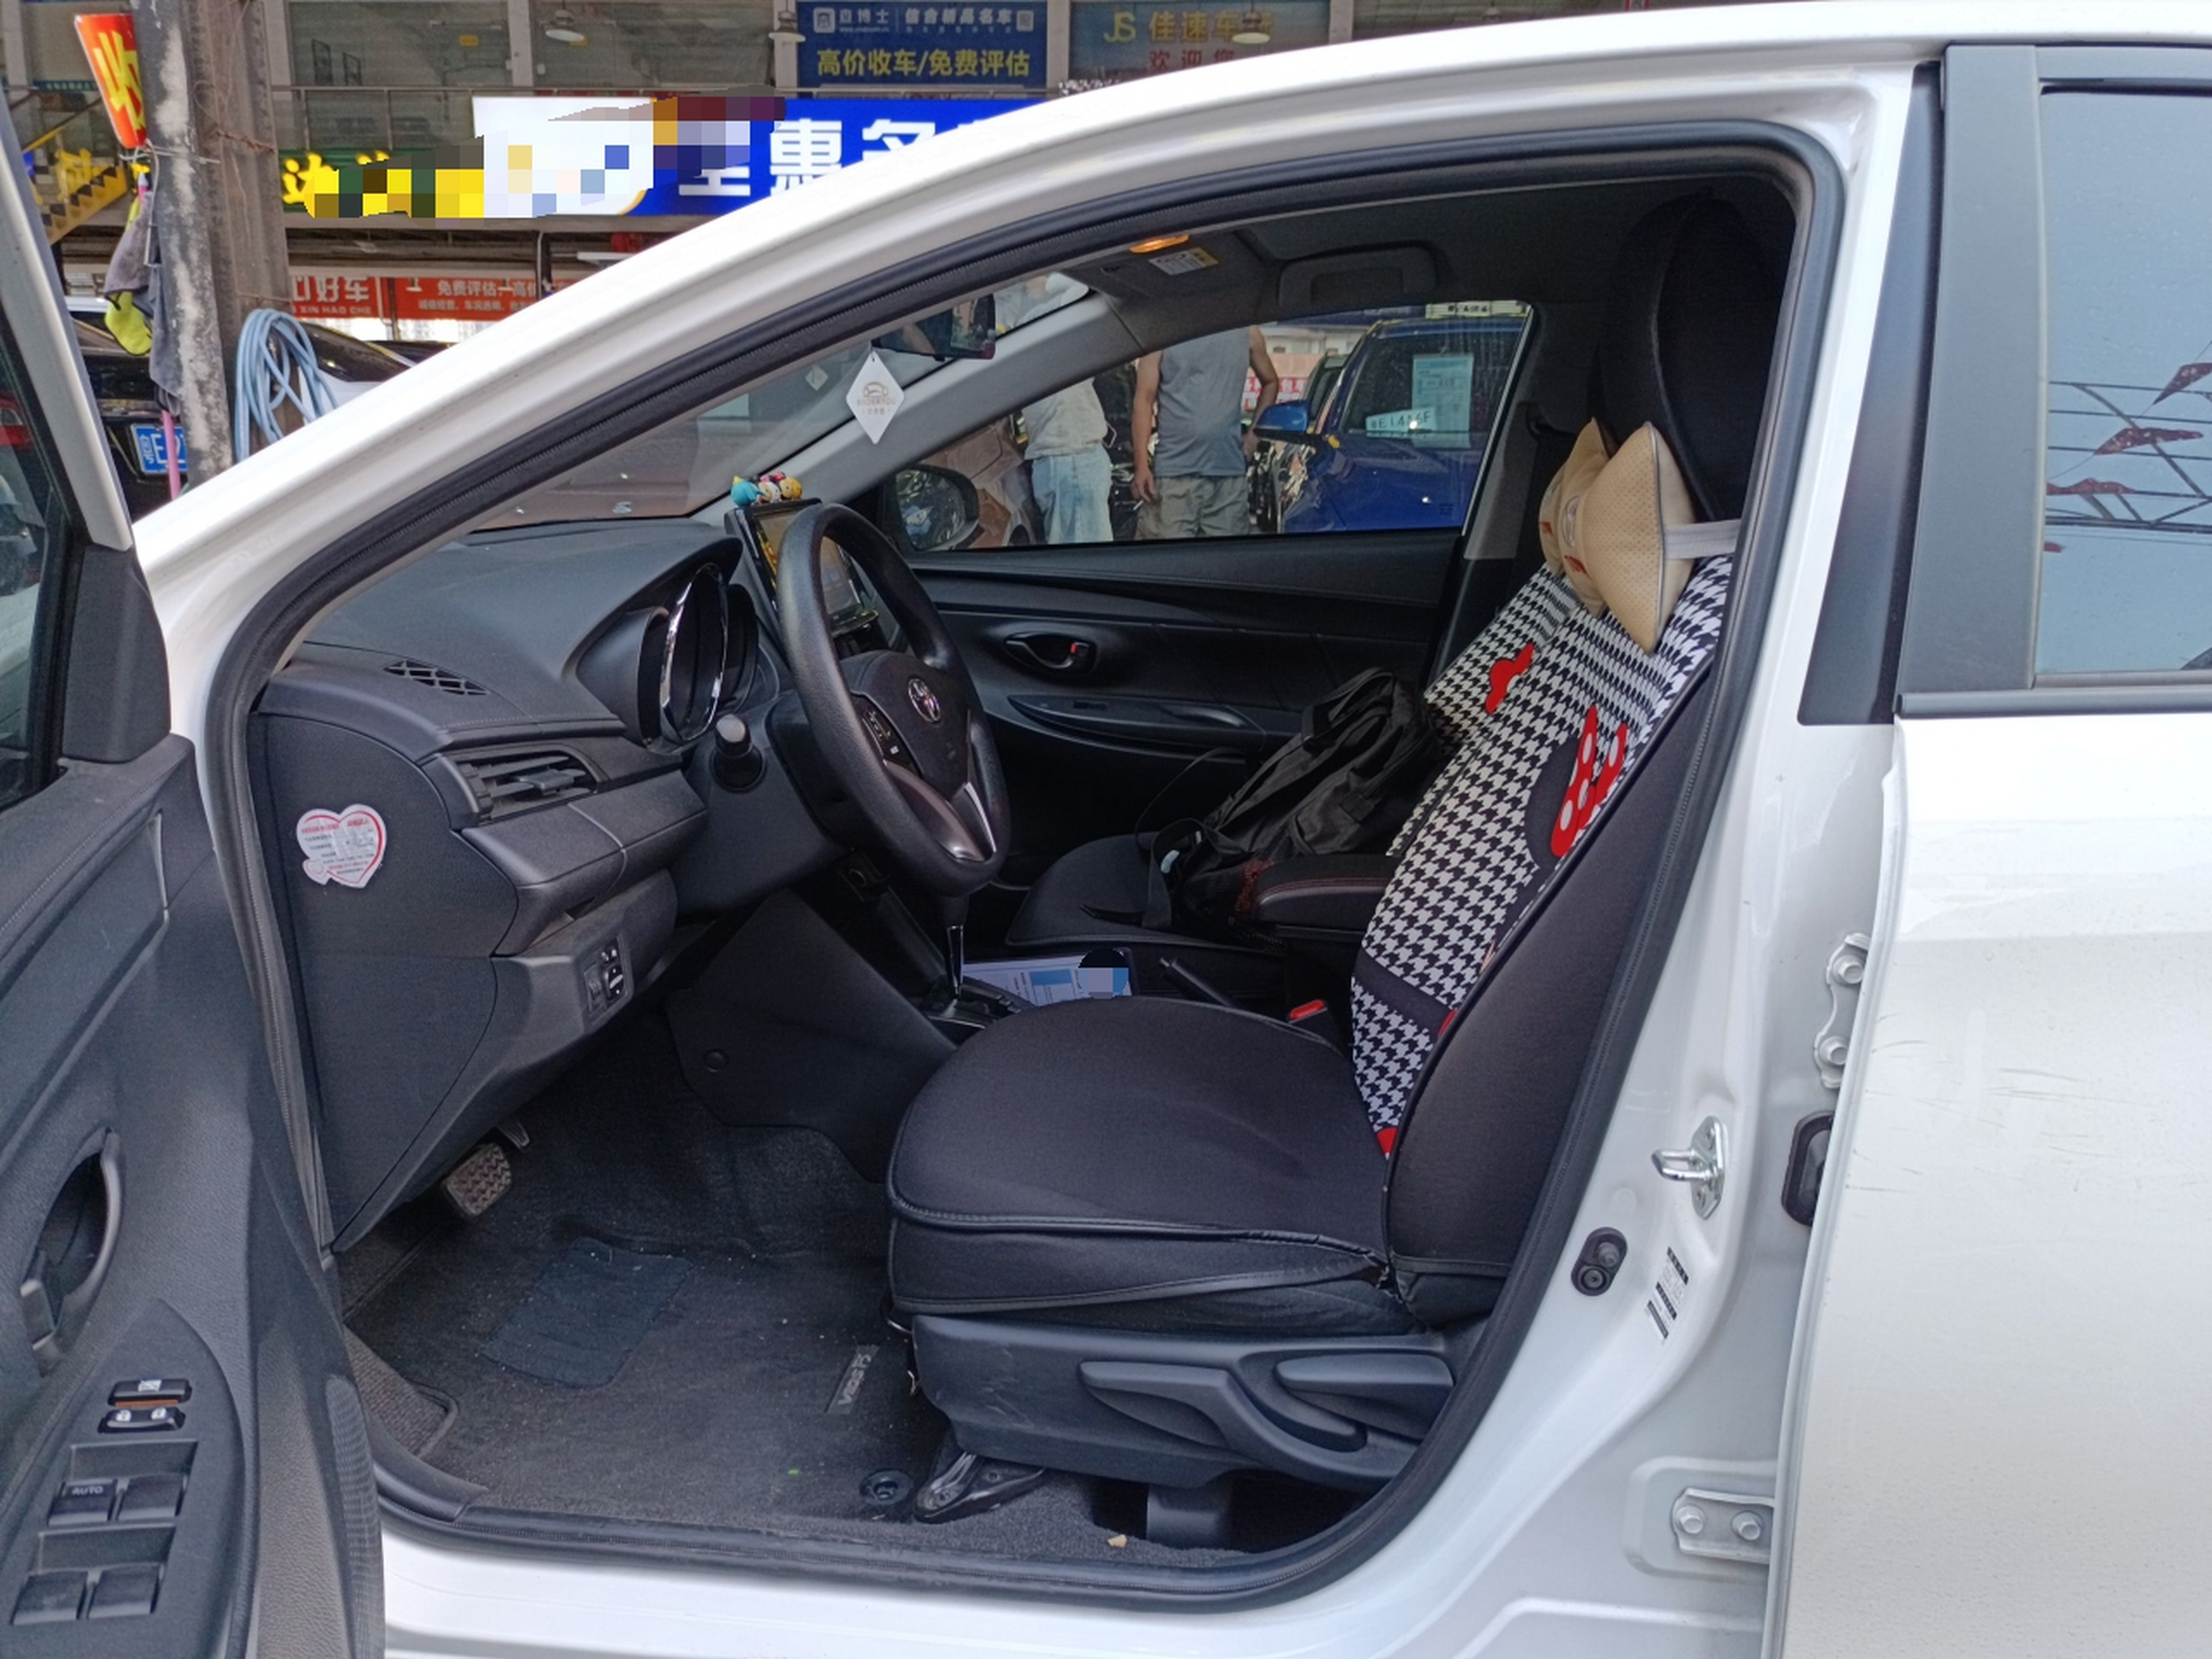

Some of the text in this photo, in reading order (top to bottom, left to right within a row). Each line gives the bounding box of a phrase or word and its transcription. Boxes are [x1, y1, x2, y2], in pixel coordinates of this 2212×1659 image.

[817, 49, 1031, 77] 高价收车/免费评估
[71, 1485, 104, 1495] AUTO
